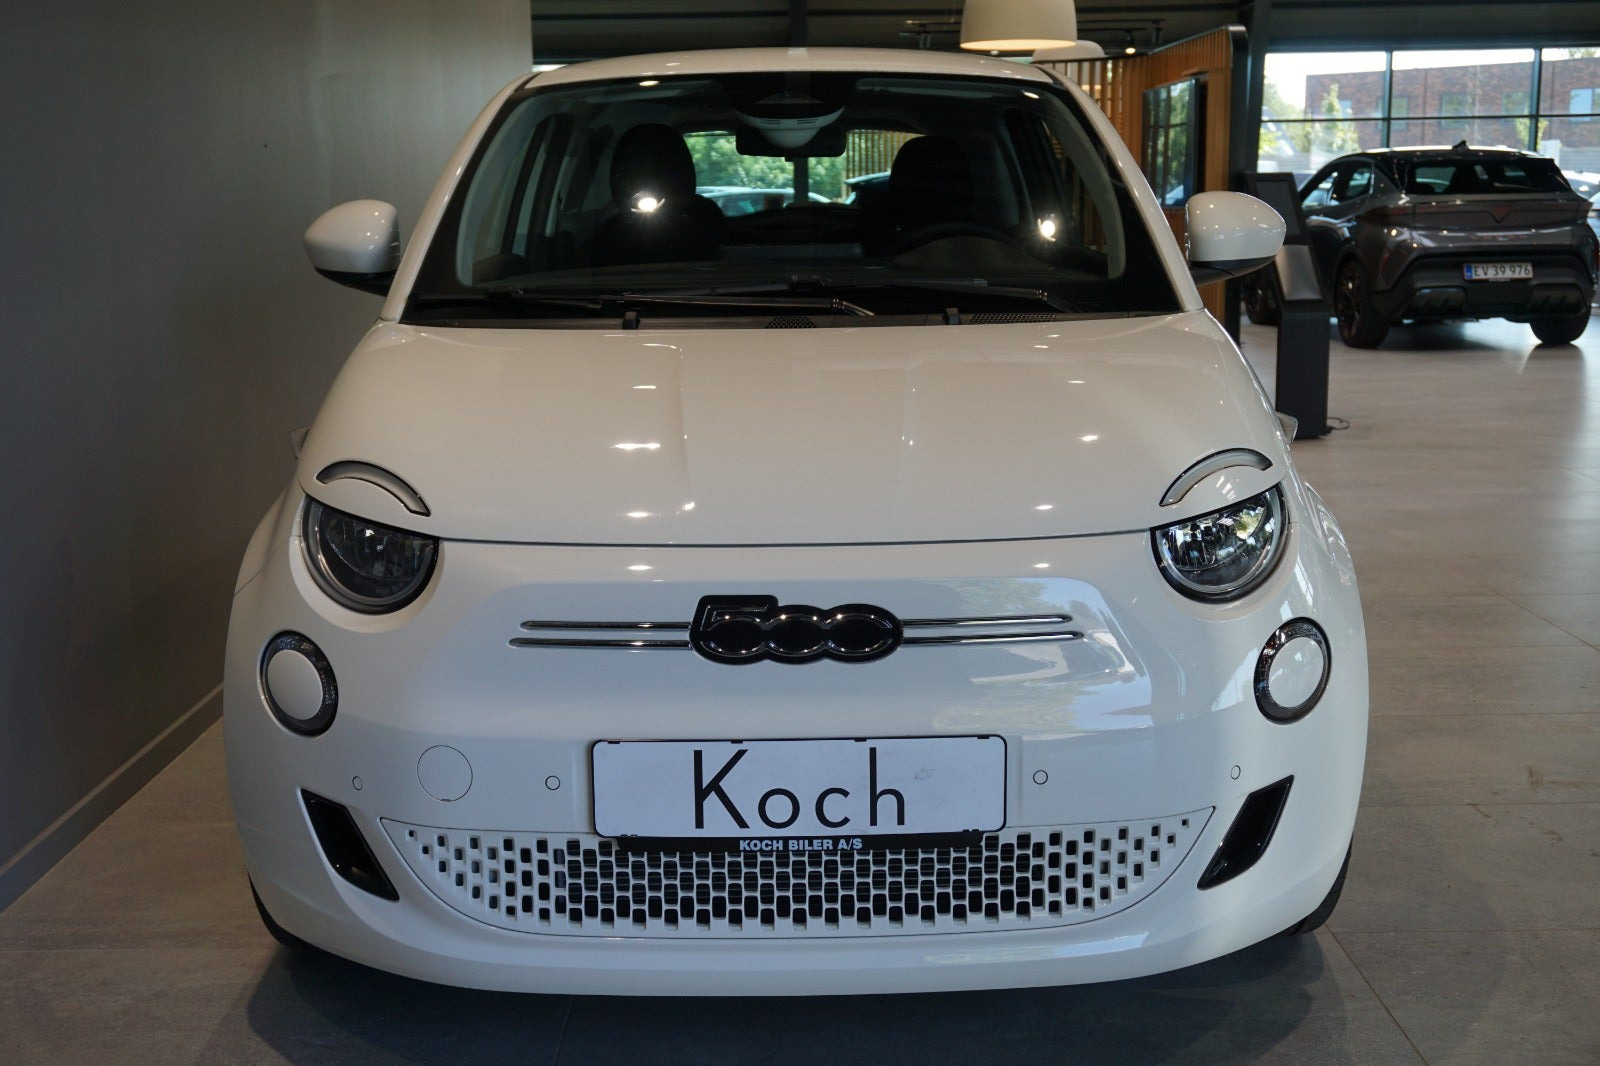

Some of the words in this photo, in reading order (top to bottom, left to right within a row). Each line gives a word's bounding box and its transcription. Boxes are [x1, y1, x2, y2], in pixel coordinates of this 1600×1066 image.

[1474, 264, 1489, 276] EV
[1492, 264, 1506, 276] 39
[1509, 264, 1531, 276] 976
[692, 597, 901, 663] 500
[693, 747, 905, 829] Koch
[740, 839, 783, 851] KOCH
[788, 839, 833, 851] BILER
[837, 838, 863, 851] A/S
